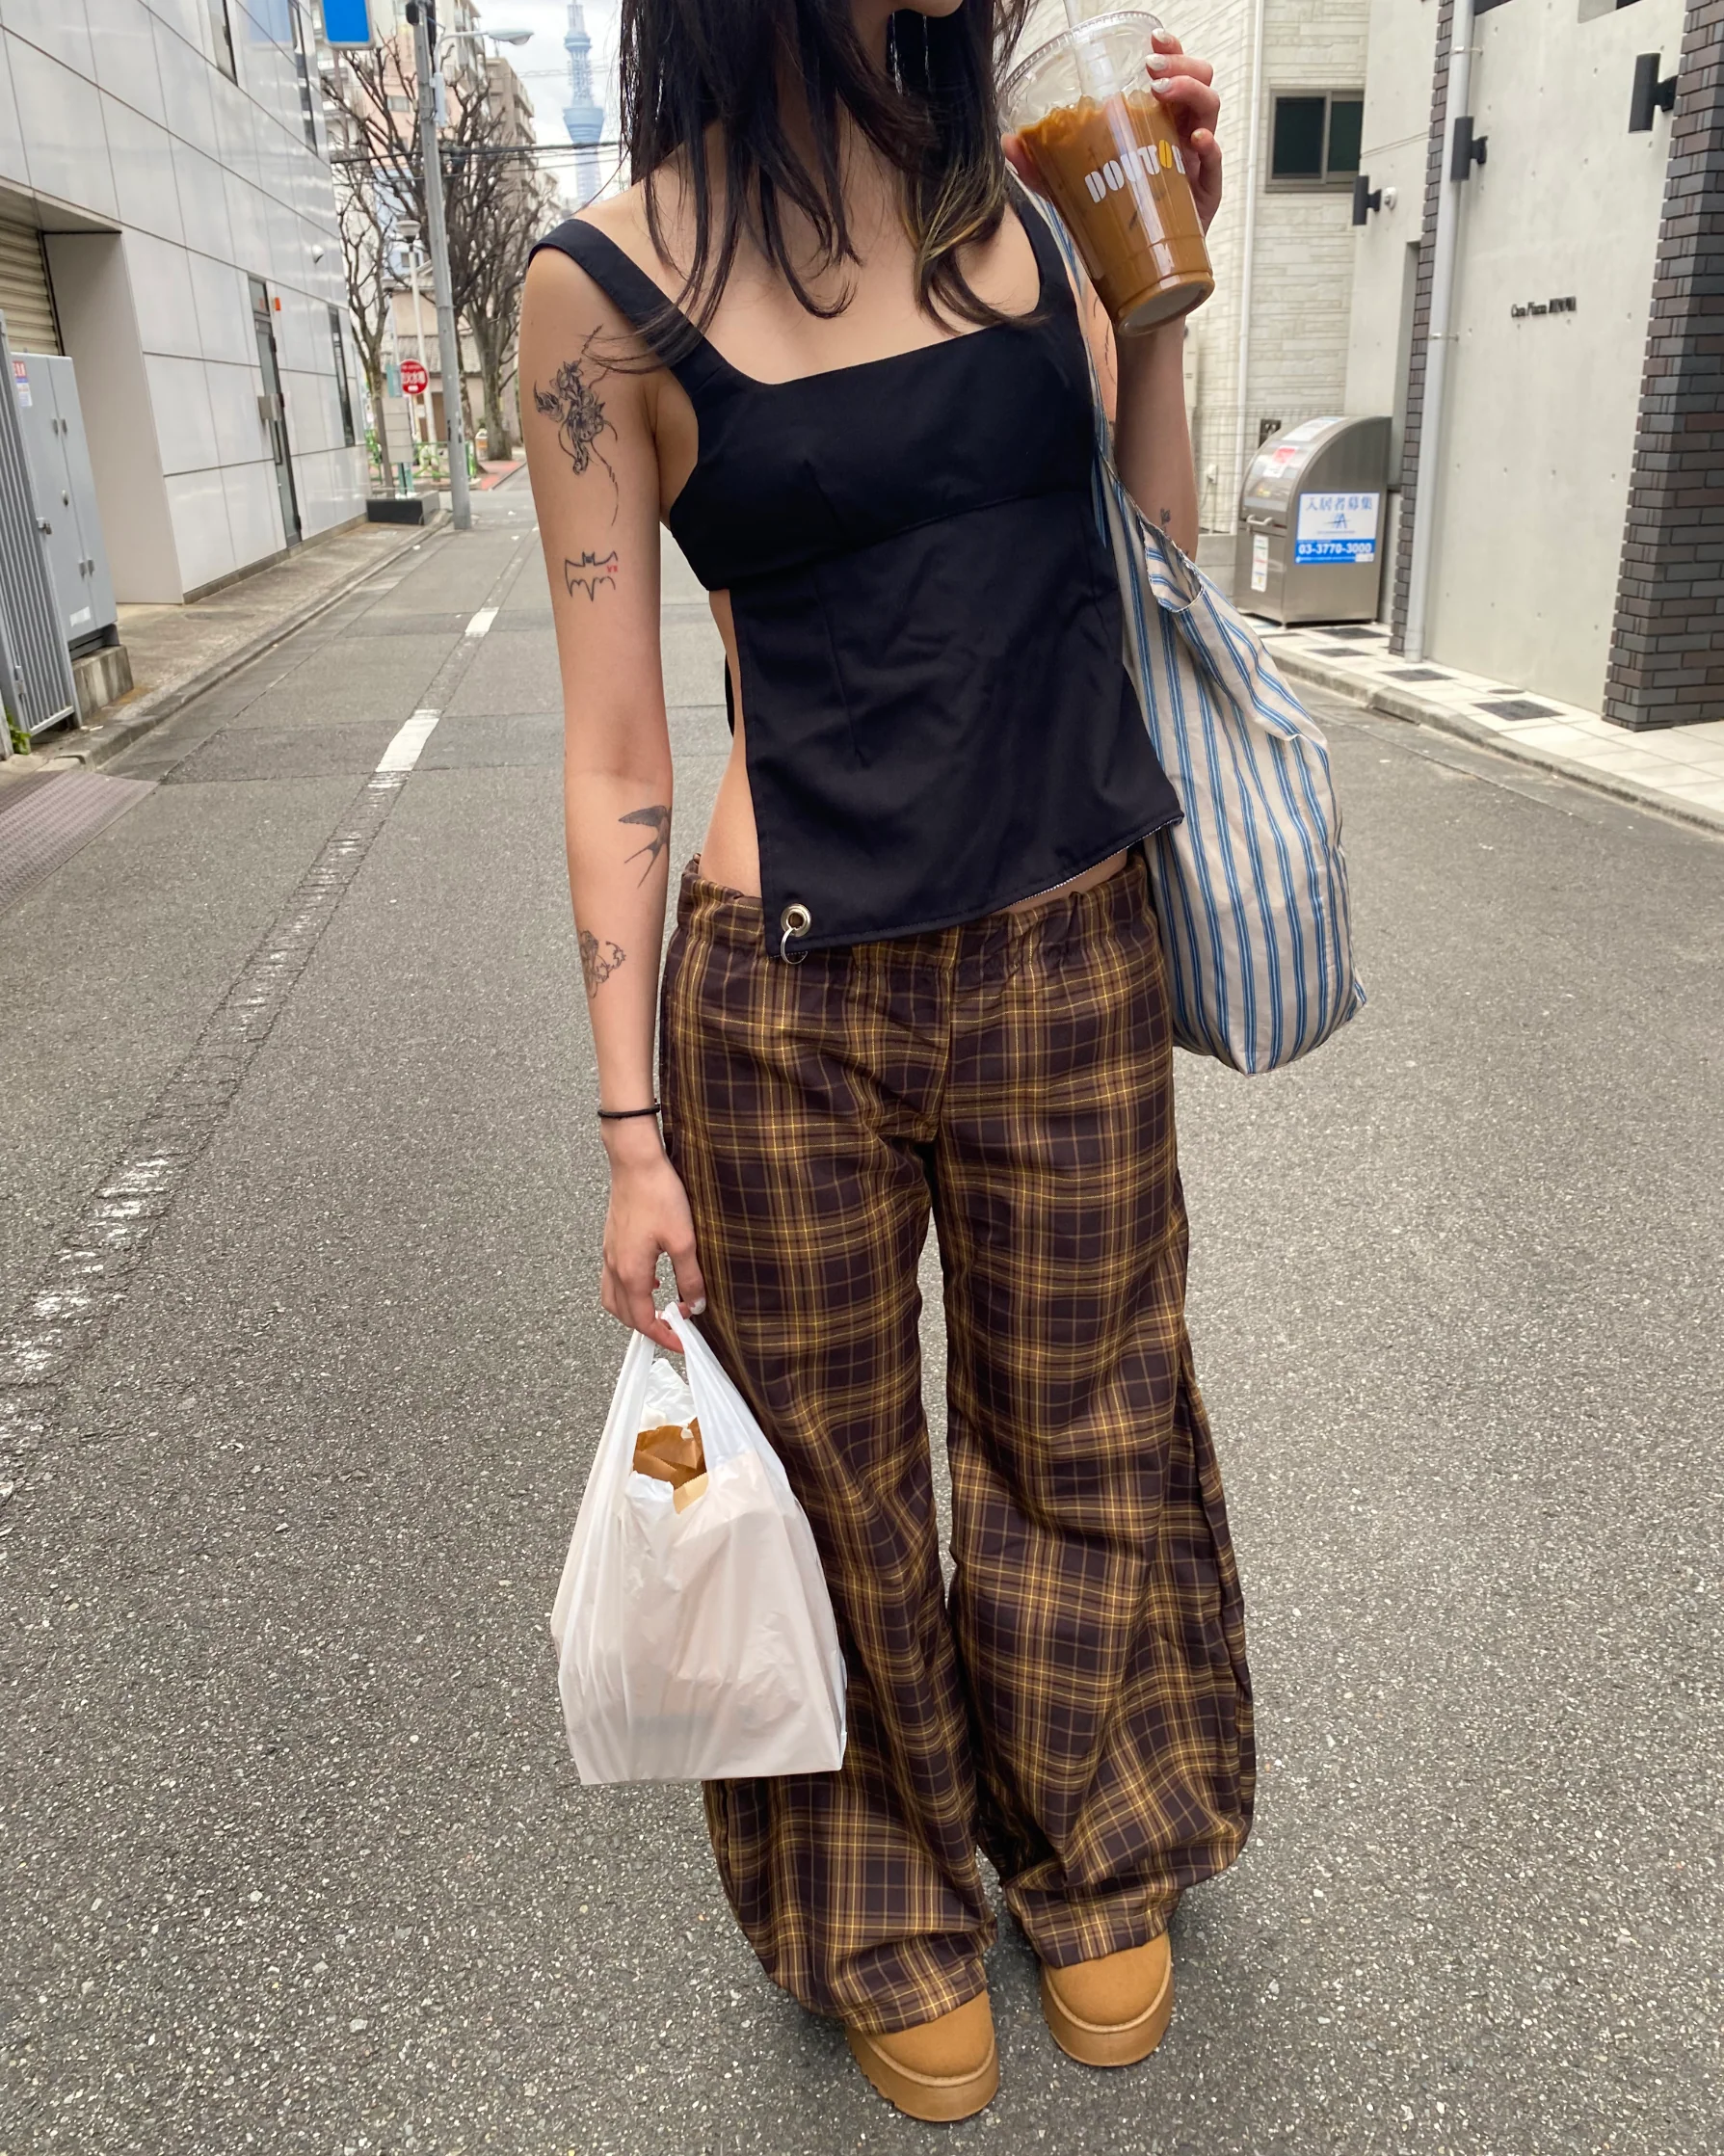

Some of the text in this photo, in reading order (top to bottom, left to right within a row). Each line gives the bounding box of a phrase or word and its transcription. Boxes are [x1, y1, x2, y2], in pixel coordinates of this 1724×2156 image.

[1306, 496, 1373, 511] 入居者募集
[1298, 542, 1372, 554] 03-3770-3000
